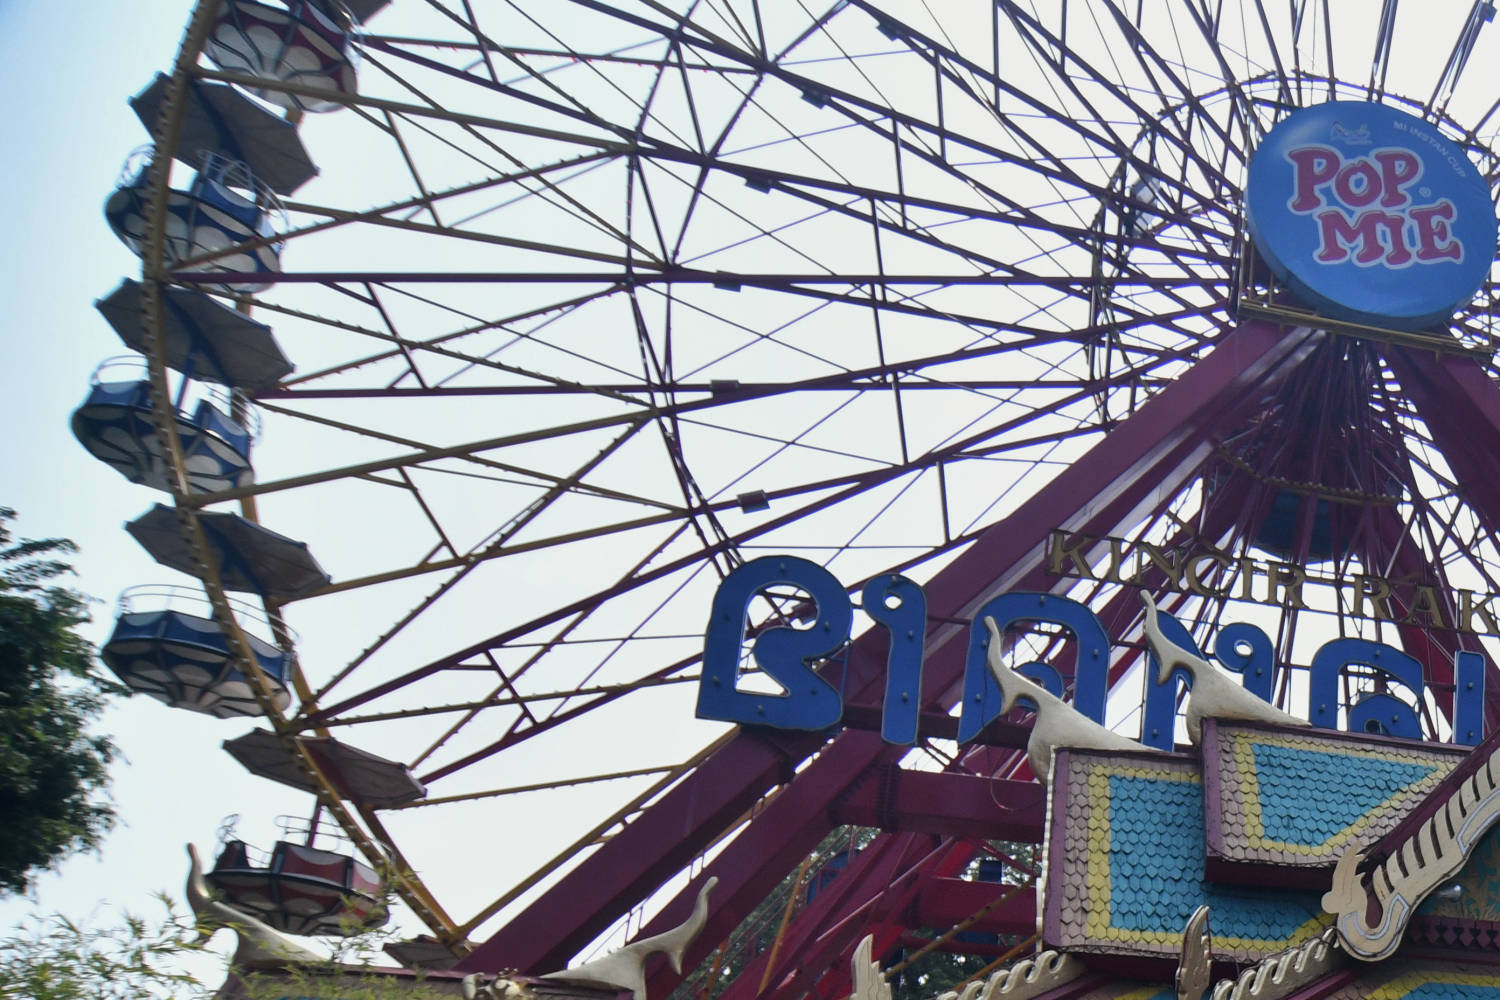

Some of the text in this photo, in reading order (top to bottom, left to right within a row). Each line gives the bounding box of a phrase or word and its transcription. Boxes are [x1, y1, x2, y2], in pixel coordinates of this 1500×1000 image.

[1288, 146, 1422, 212] POP
[1410, 127, 1446, 156] INSTAN
[1448, 155, 1466, 177] CUP
[1315, 202, 1463, 266] MIE
[1047, 529, 1307, 608] KINCIR
